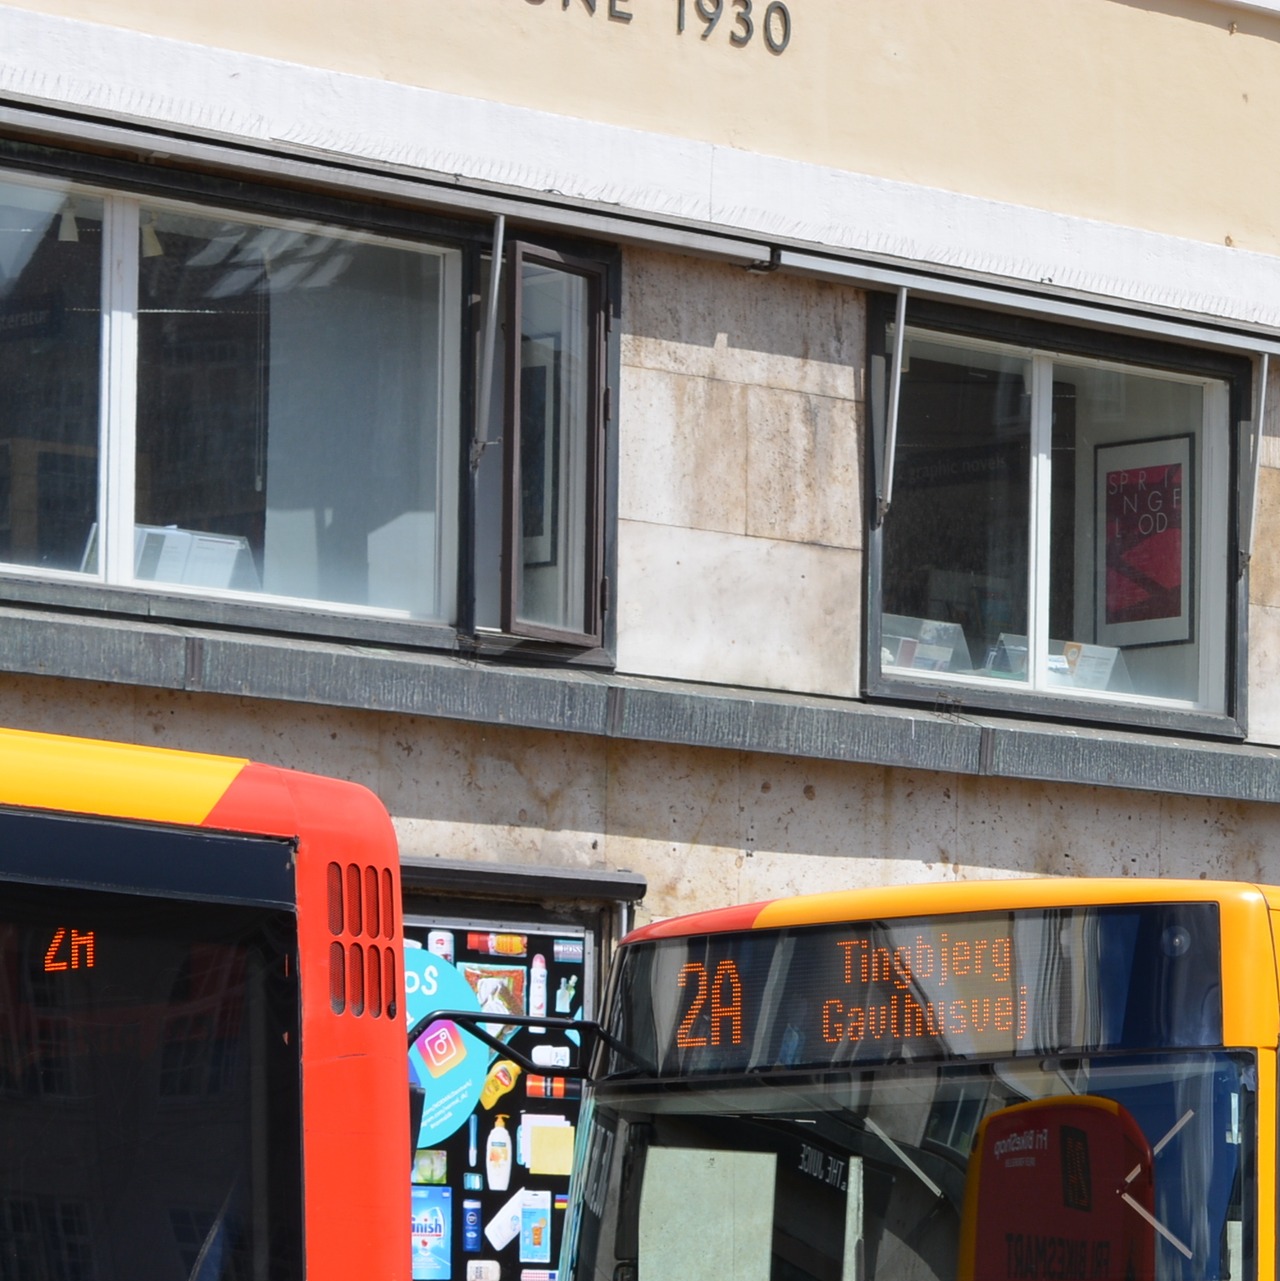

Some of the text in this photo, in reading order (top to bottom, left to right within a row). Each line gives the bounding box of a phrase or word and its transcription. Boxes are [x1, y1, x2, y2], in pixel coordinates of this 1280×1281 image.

[676, 0, 791, 51] 1930
[836, 932, 1011, 990] Tingbjerg
[677, 959, 742, 1048] 2A
[822, 984, 1028, 1043] Gavlhusvej
